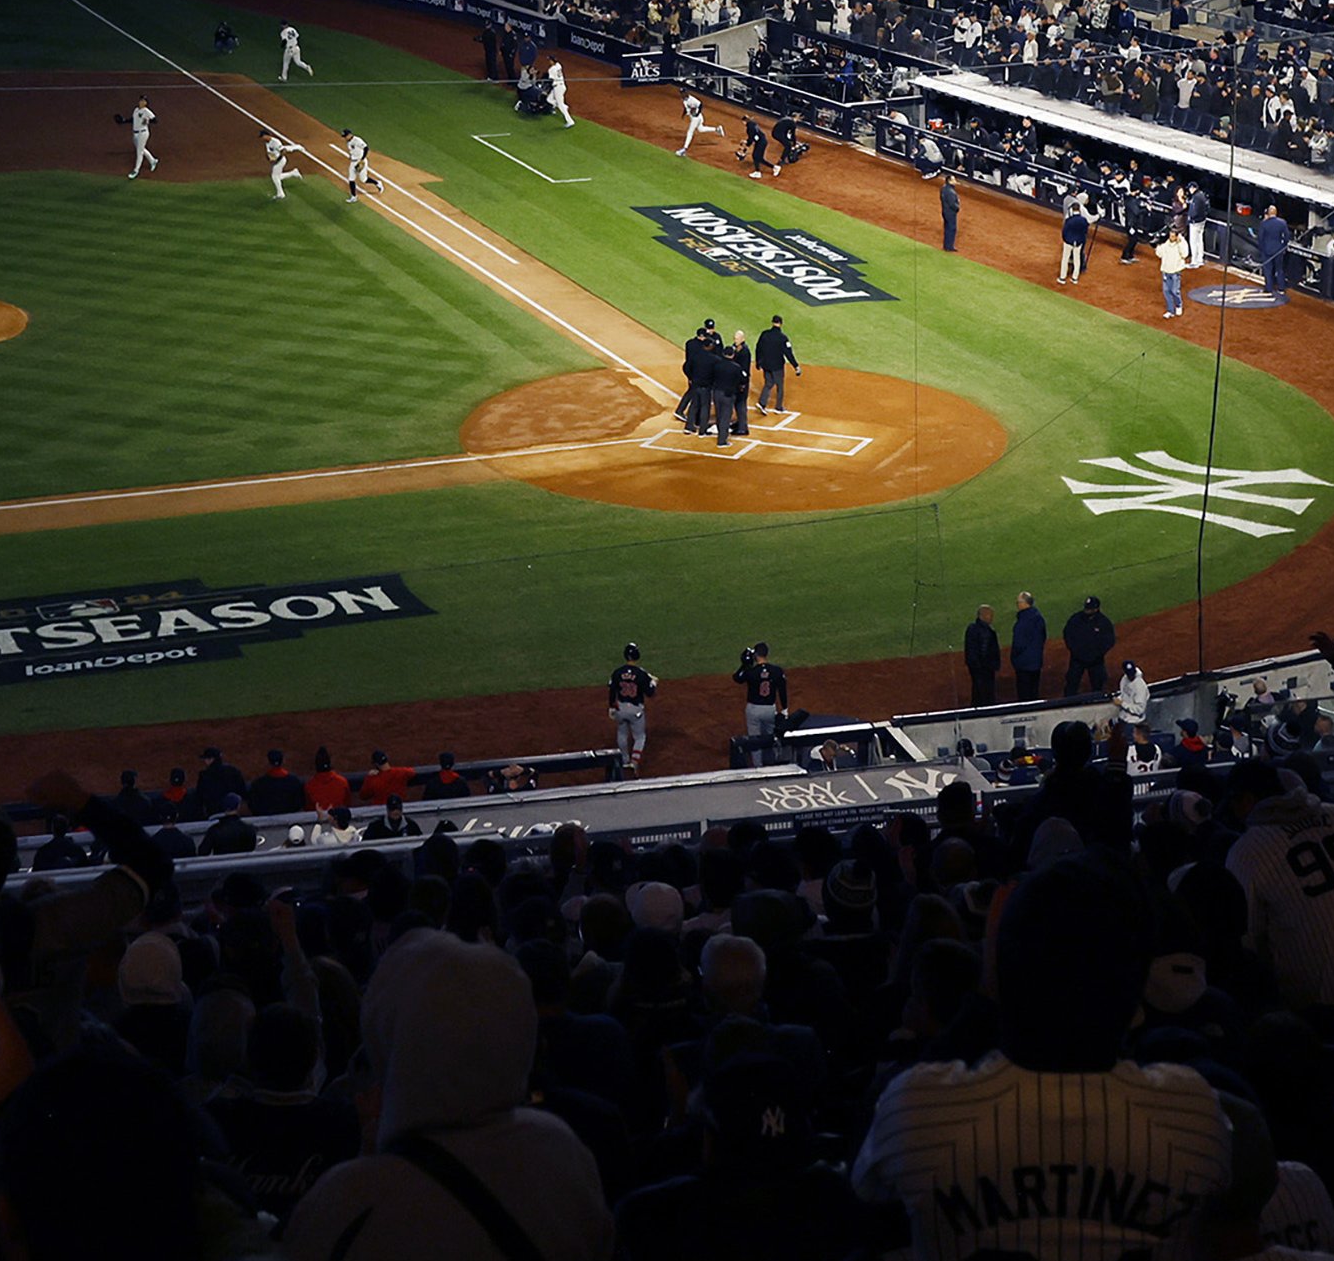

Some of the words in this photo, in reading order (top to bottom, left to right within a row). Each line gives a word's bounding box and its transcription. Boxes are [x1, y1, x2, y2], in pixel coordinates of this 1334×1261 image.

[571, 31, 605, 55] loanDepot
[630, 67, 661, 80] ALCS
[660, 206, 872, 301] POSTSEASON
[24, 645, 199, 677] loanDepot
[755, 790, 857, 812] YORK
[759, 780, 833, 801] NEW
[932, 1163, 1195, 1238] MARTINEZ
